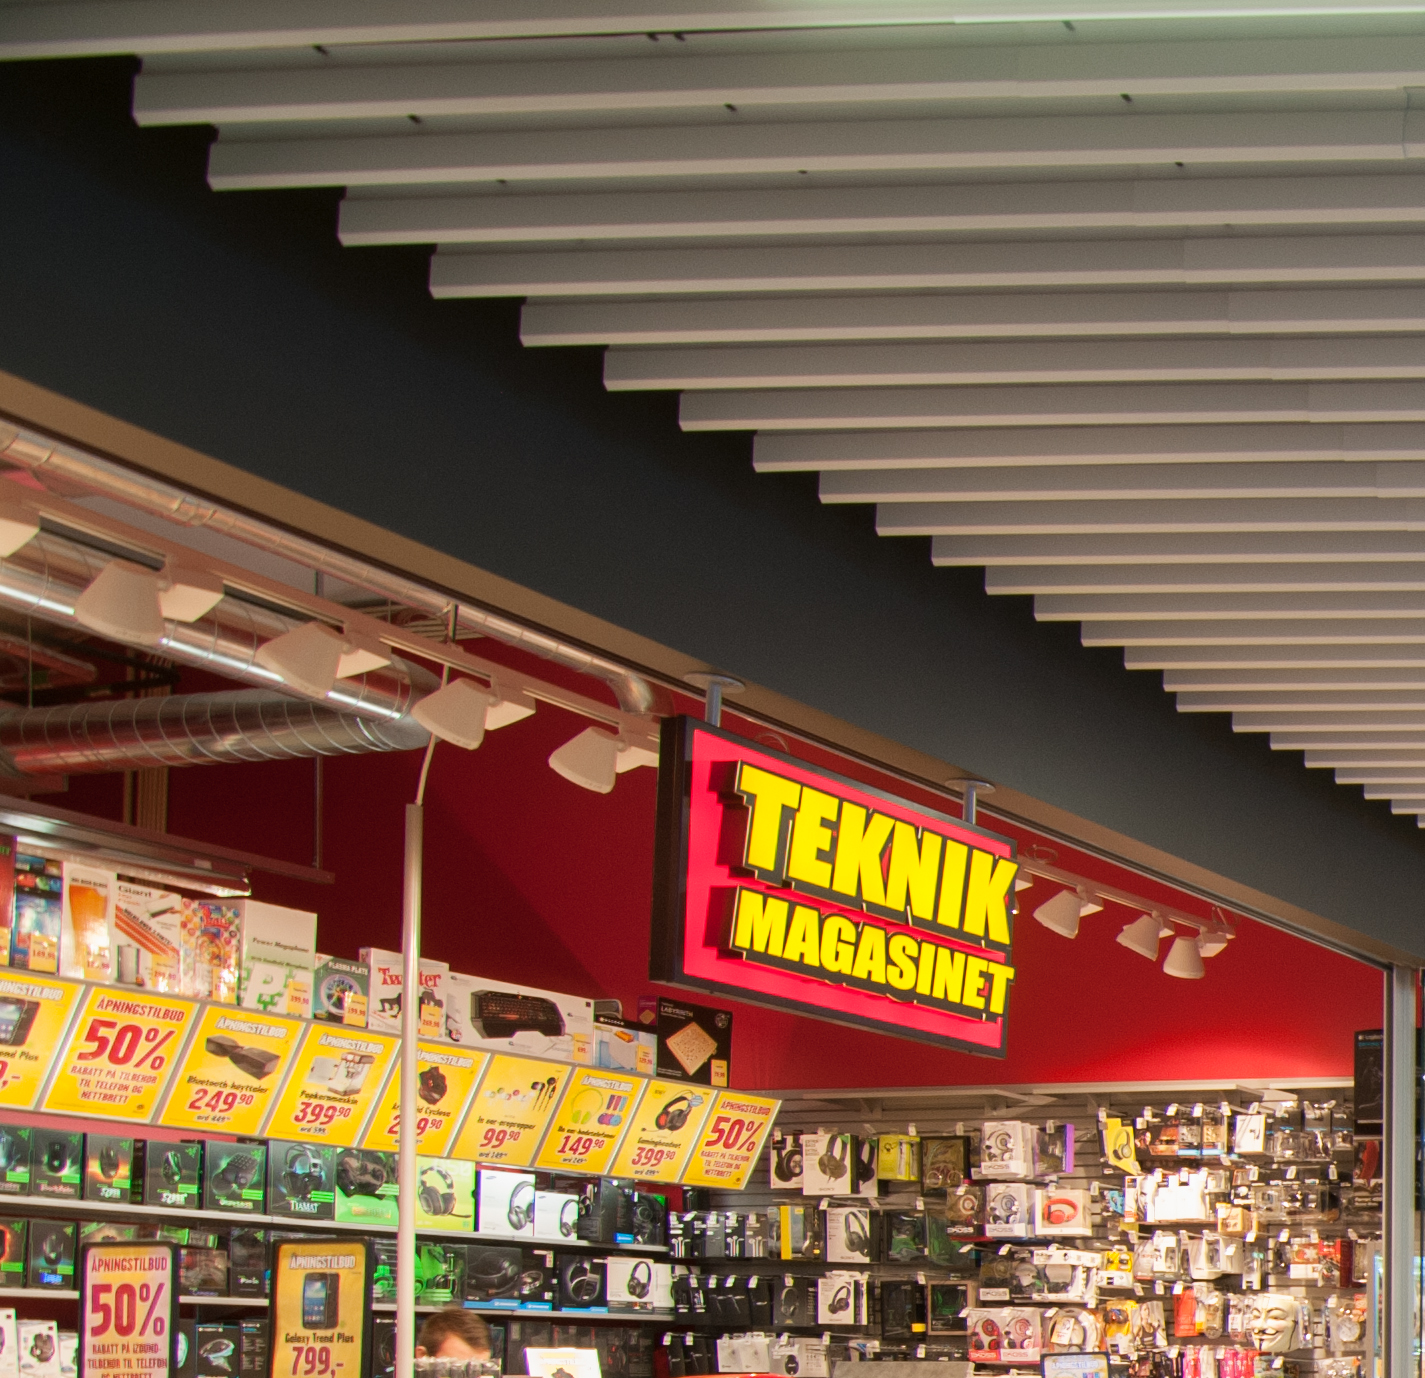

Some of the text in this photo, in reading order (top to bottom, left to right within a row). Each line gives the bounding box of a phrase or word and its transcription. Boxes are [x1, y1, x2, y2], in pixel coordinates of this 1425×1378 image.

[738, 764, 1018, 946] TEKNIK
[734, 890, 1015, 1015] MAGASINET
[378, 967, 441, 989] Twter
[97, 995, 185, 1022] ÅPNINGSTILBUD
[77, 1018, 176, 1071] 50%
[79, 1078, 90, 1089] TIL
[95, 1081, 129, 1093] TELEFON
[387, 1114, 430, 1137] 29
[705, 1116, 763, 1153] 50%
[290, 1200, 320, 1213] TIAMAT
[92, 1255, 167, 1272] ÅPNINGSTILBUD
[289, 1253, 355, 1269] ÅPNINGSTILBUD
[90, 1282, 166, 1338] 50%
[92, 1344, 119, 1355] RABATT
[285, 1332, 355, 1345] Galaxy Trend Plus
[123, 1358, 133, 1369] TIL
[136, 1357, 168, 1369] TELEFON
